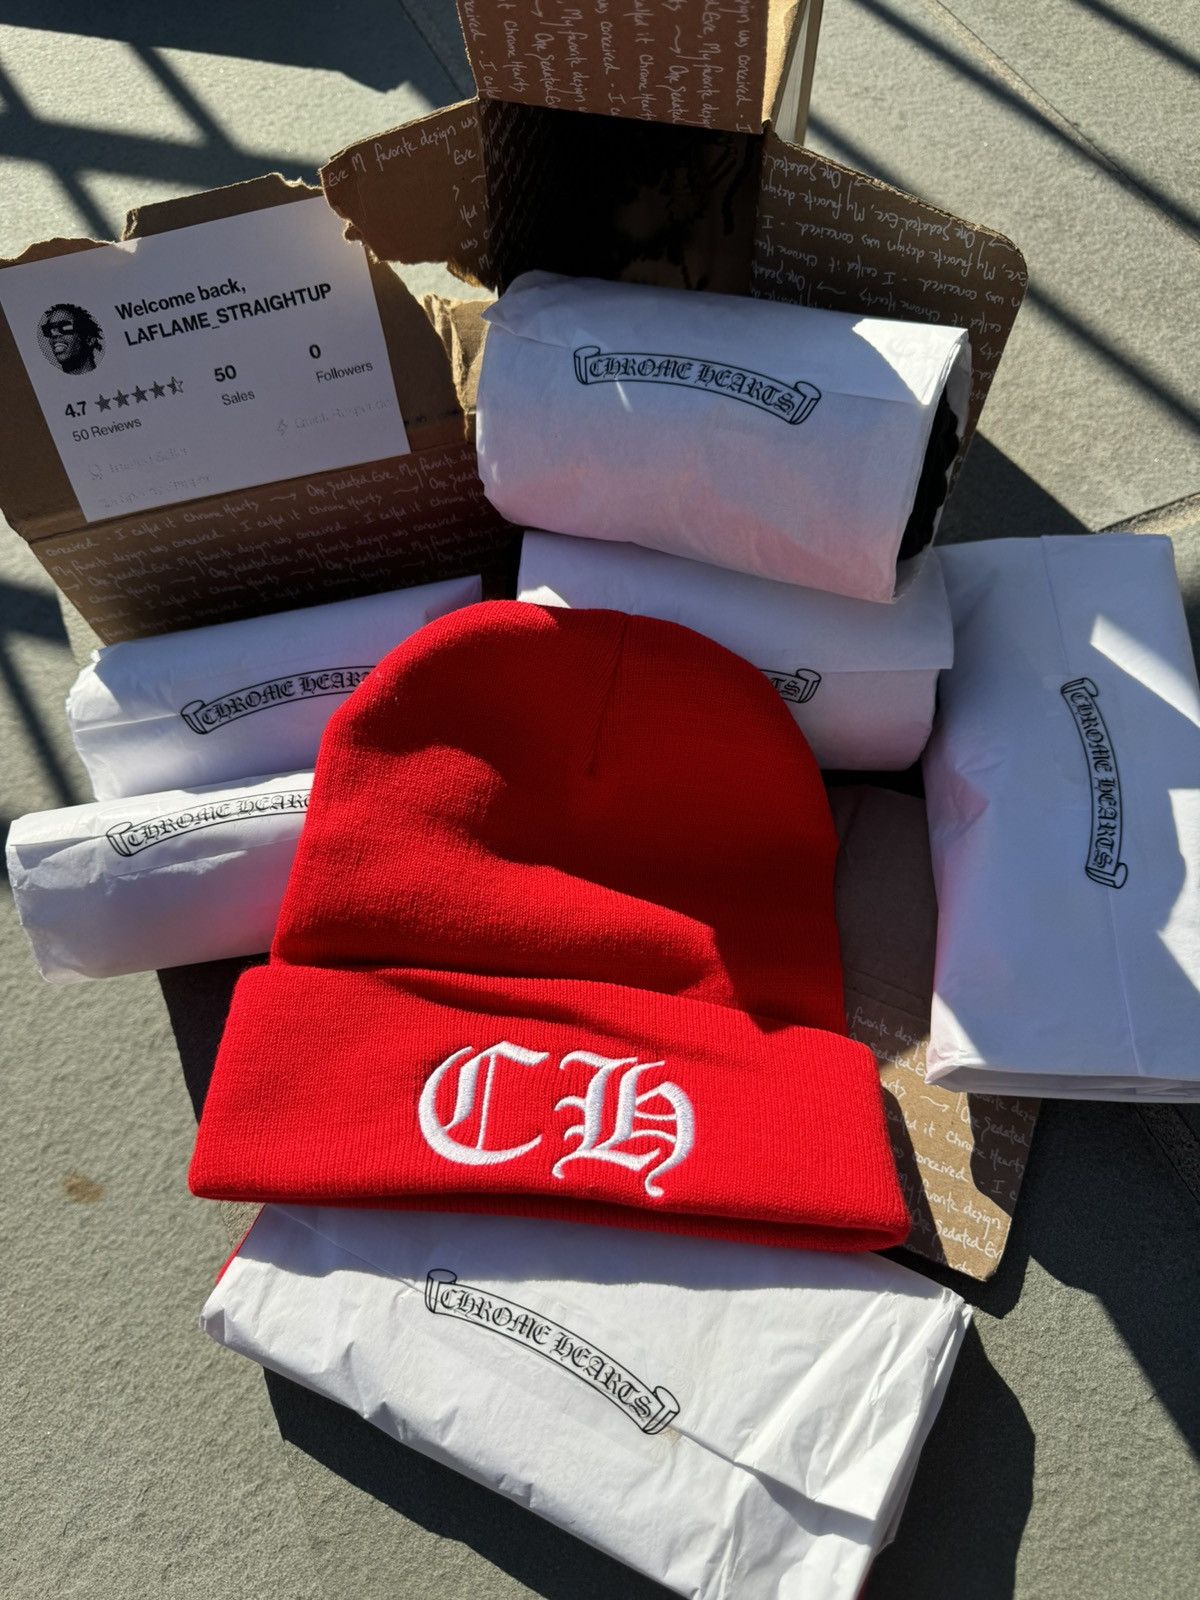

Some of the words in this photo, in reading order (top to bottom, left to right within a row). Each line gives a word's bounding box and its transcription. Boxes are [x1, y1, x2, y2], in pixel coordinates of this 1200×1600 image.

[374, 136, 418, 171] favorite
[420, 125, 457, 155] design
[799, 192, 842, 220] favorite
[795, 221, 854, 244] conceived
[861, 233, 880, 248] was
[954, 226, 976, 248] One
[881, 271, 896, 285] I
[929, 252, 973, 278] favorite
[115, 290, 196, 320] Welcome
[197, 278, 246, 301] back,
[985, 290, 1004, 305] was
[124, 283, 332, 346] LAFLAME_STRAIGHTUP
[309, 344, 321, 359] 0
[214, 365, 237, 382] 50
[315, 361, 373, 383] Followers
[221, 389, 255, 406] Sales
[589, 357, 694, 379] CHROME
[697, 361, 796, 416] HEARTS
[65, 401, 87, 418] 4.7
[72, 428, 90, 442] 50
[91, 418, 142, 438] Reviews
[201, 680, 296, 725] CHROME
[1071, 689, 1112, 773] CHROME
[1093, 777, 1118, 868] HEARTS
[128, 803, 230, 847] CHROME
[418, 1040, 694, 1197] CH
[923, 1120, 936, 1138] it
[945, 1130, 986, 1159] Chrome
[914, 1150, 970, 1182] conceived
[991, 1179, 1004, 1194] I
[963, 1200, 1004, 1241] design
[440, 1288, 551, 1346] CHROME
[551, 1331, 653, 1421] HEARTS
